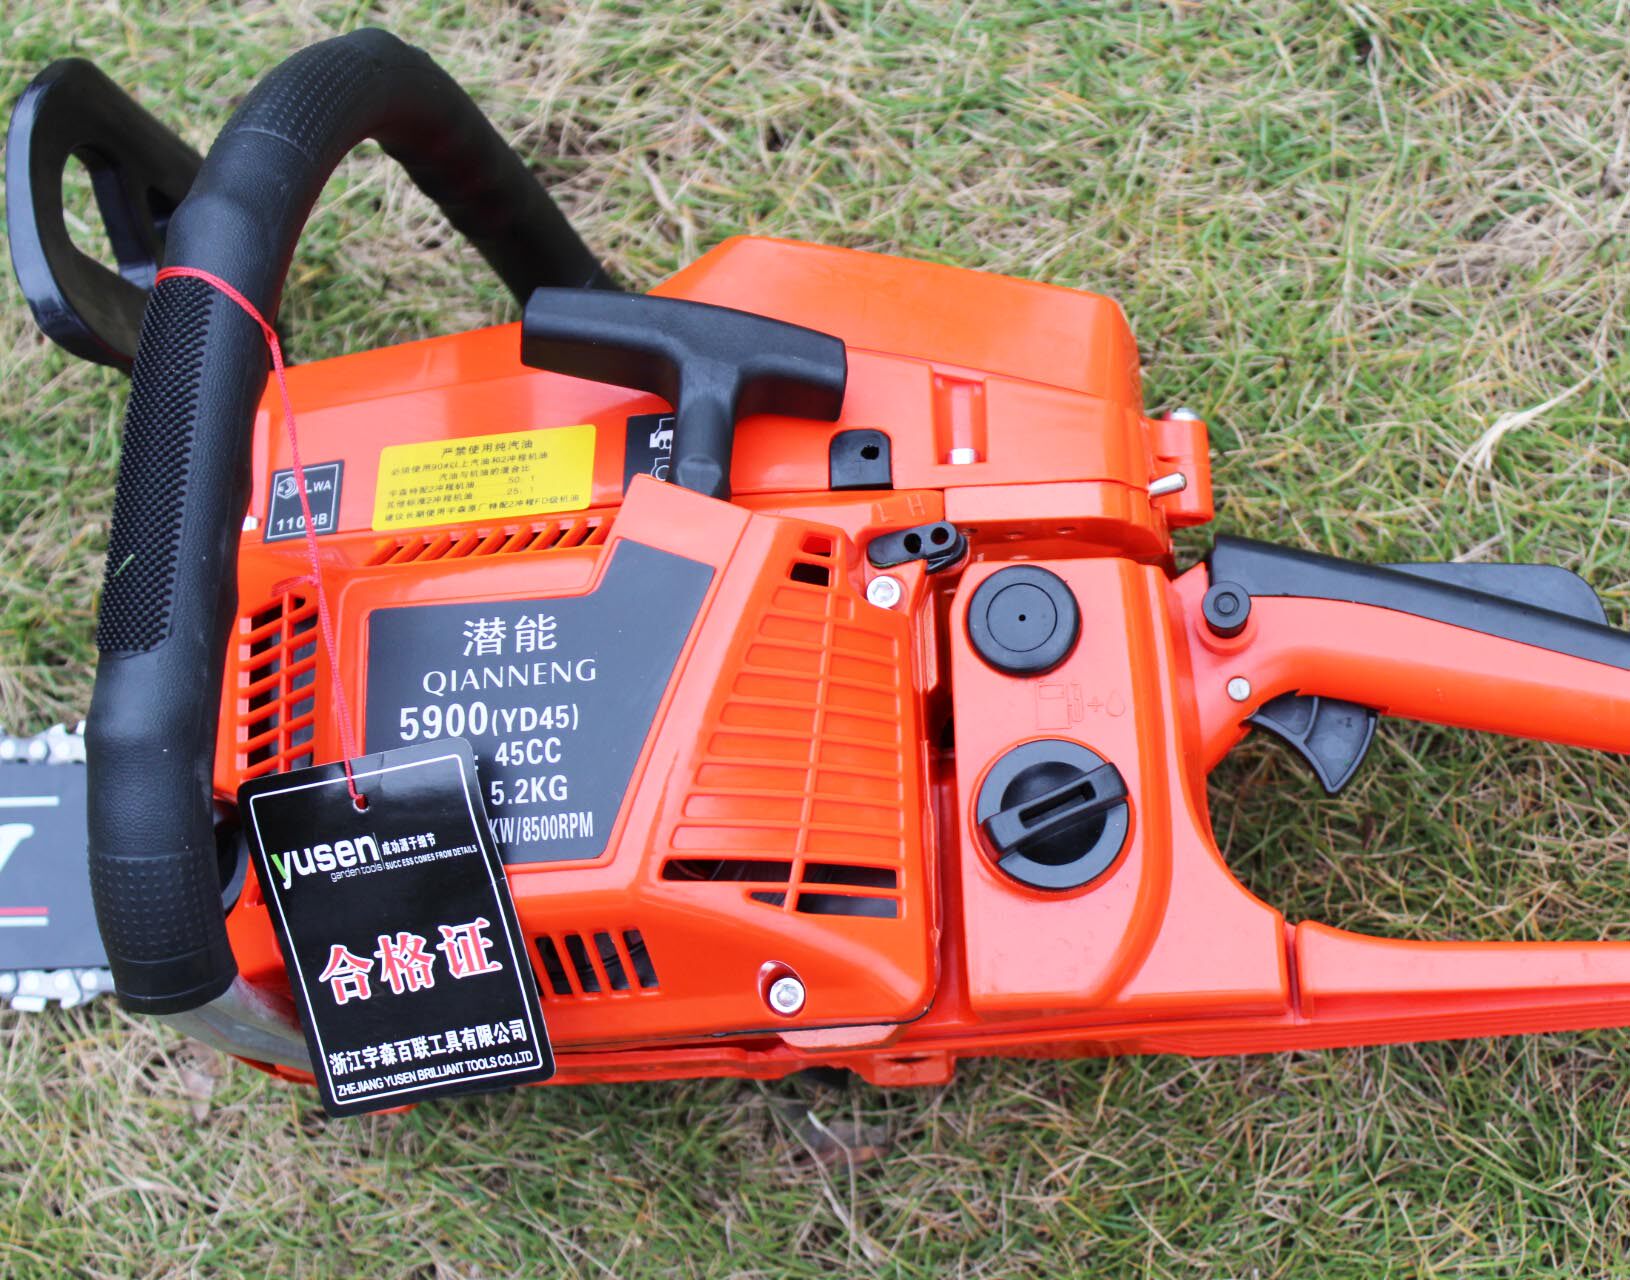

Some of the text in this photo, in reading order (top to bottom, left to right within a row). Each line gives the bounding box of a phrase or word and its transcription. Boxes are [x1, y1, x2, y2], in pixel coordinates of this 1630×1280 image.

[441, 440, 533, 459] 严禁使用纯汽油
[276, 515, 306, 532] 110
[461, 613, 558, 657] 潜能
[422, 658, 597, 697] QIANNENG
[494, 737, 562, 767] 45CC
[490, 774, 568, 806] 5.2KG
[381, 832, 436, 856] 成功源于细节
[413, 853, 436, 864] COMES
[435, 847, 453, 860] FROM
[452, 844, 478, 857] DETAILS
[270, 835, 380, 890] yusen
[330, 866, 361, 882] garden
[318, 916, 502, 1005] 合格证
[328, 1018, 527, 1076] 浙江宇森百联工具有限公司
[336, 1077, 384, 1097] ZHEJIANG
[383, 1070, 417, 1087] YUSEN
[416, 1061, 465, 1081] BRILLIANT
[464, 1056, 498, 1072] TOOLS
